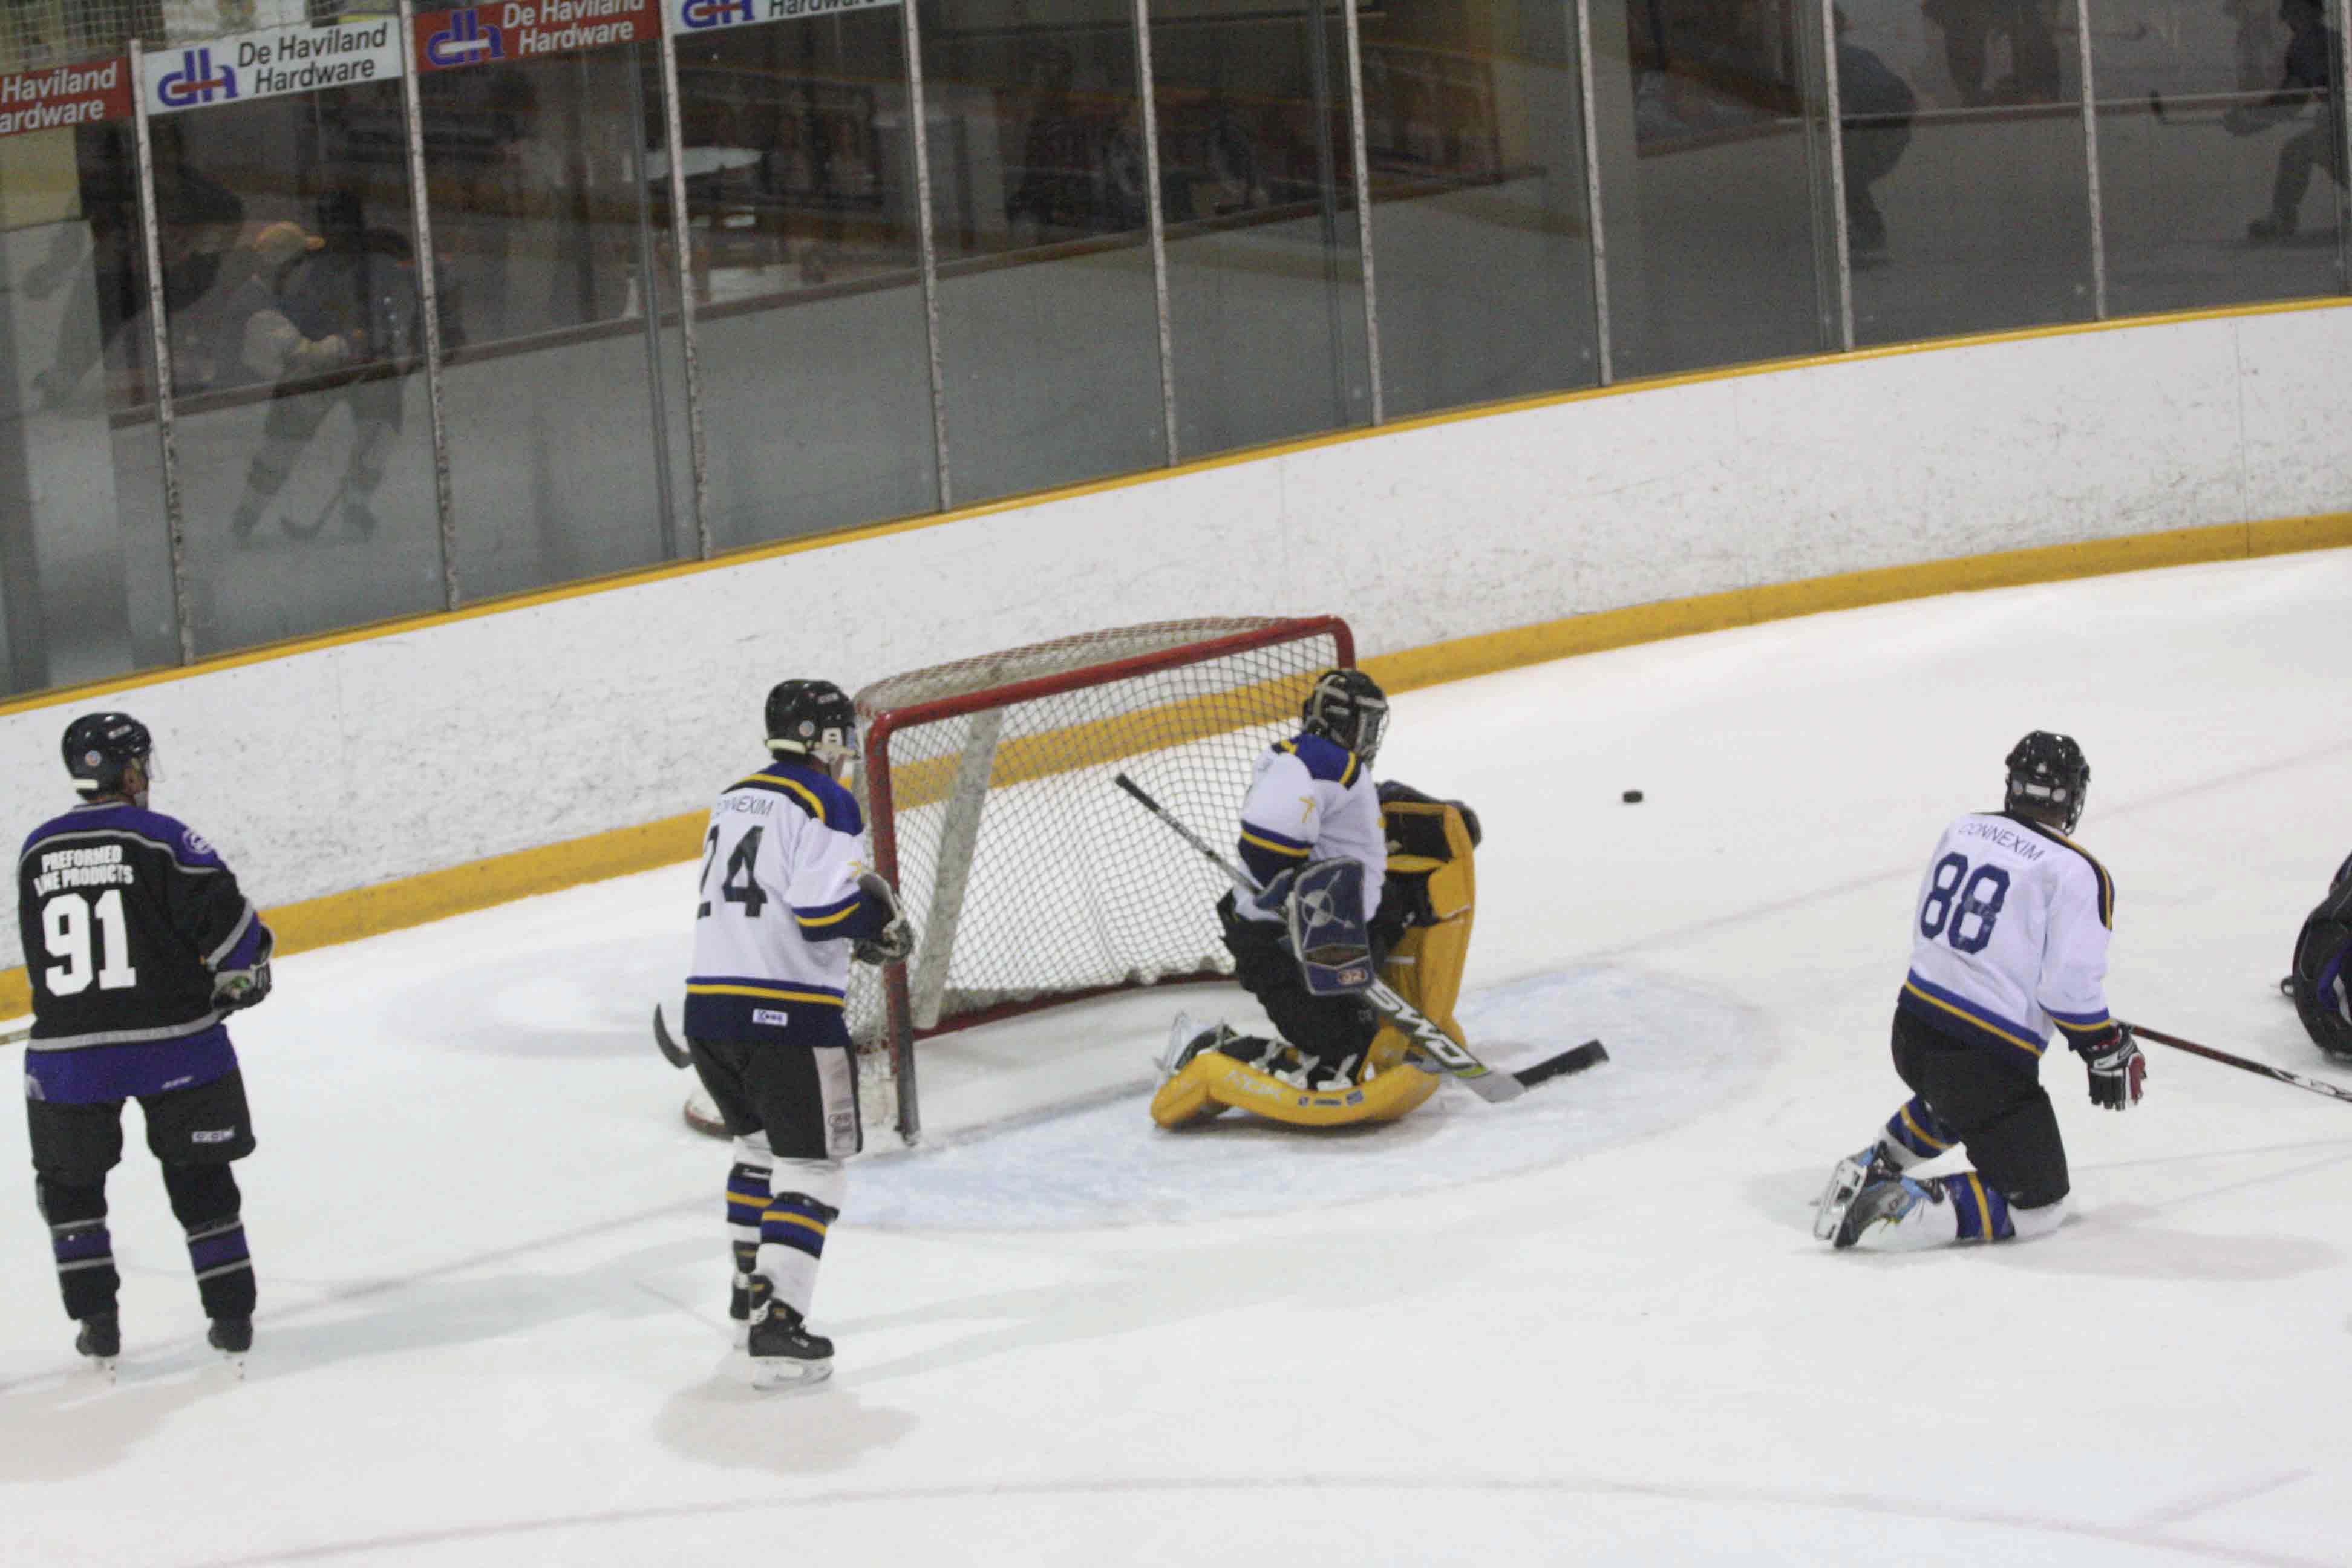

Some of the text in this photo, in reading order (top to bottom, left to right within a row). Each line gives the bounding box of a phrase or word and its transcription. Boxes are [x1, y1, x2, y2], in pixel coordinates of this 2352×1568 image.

[503, 2, 536, 30] De
[769, 0, 874, 17] Hardw
[238, 22, 388, 68] De Haviland
[518, 20, 634, 56] Hardware
[1, 60, 117, 103] Haviland
[255, 58, 375, 94] Hardware
[711, 795, 774, 820] NEXIM
[41, 844, 123, 874] PREFORMED
[33, 864, 134, 898] LINE PRODUCTS
[1920, 851, 2011, 955] 88
[42, 889, 137, 998] 91
